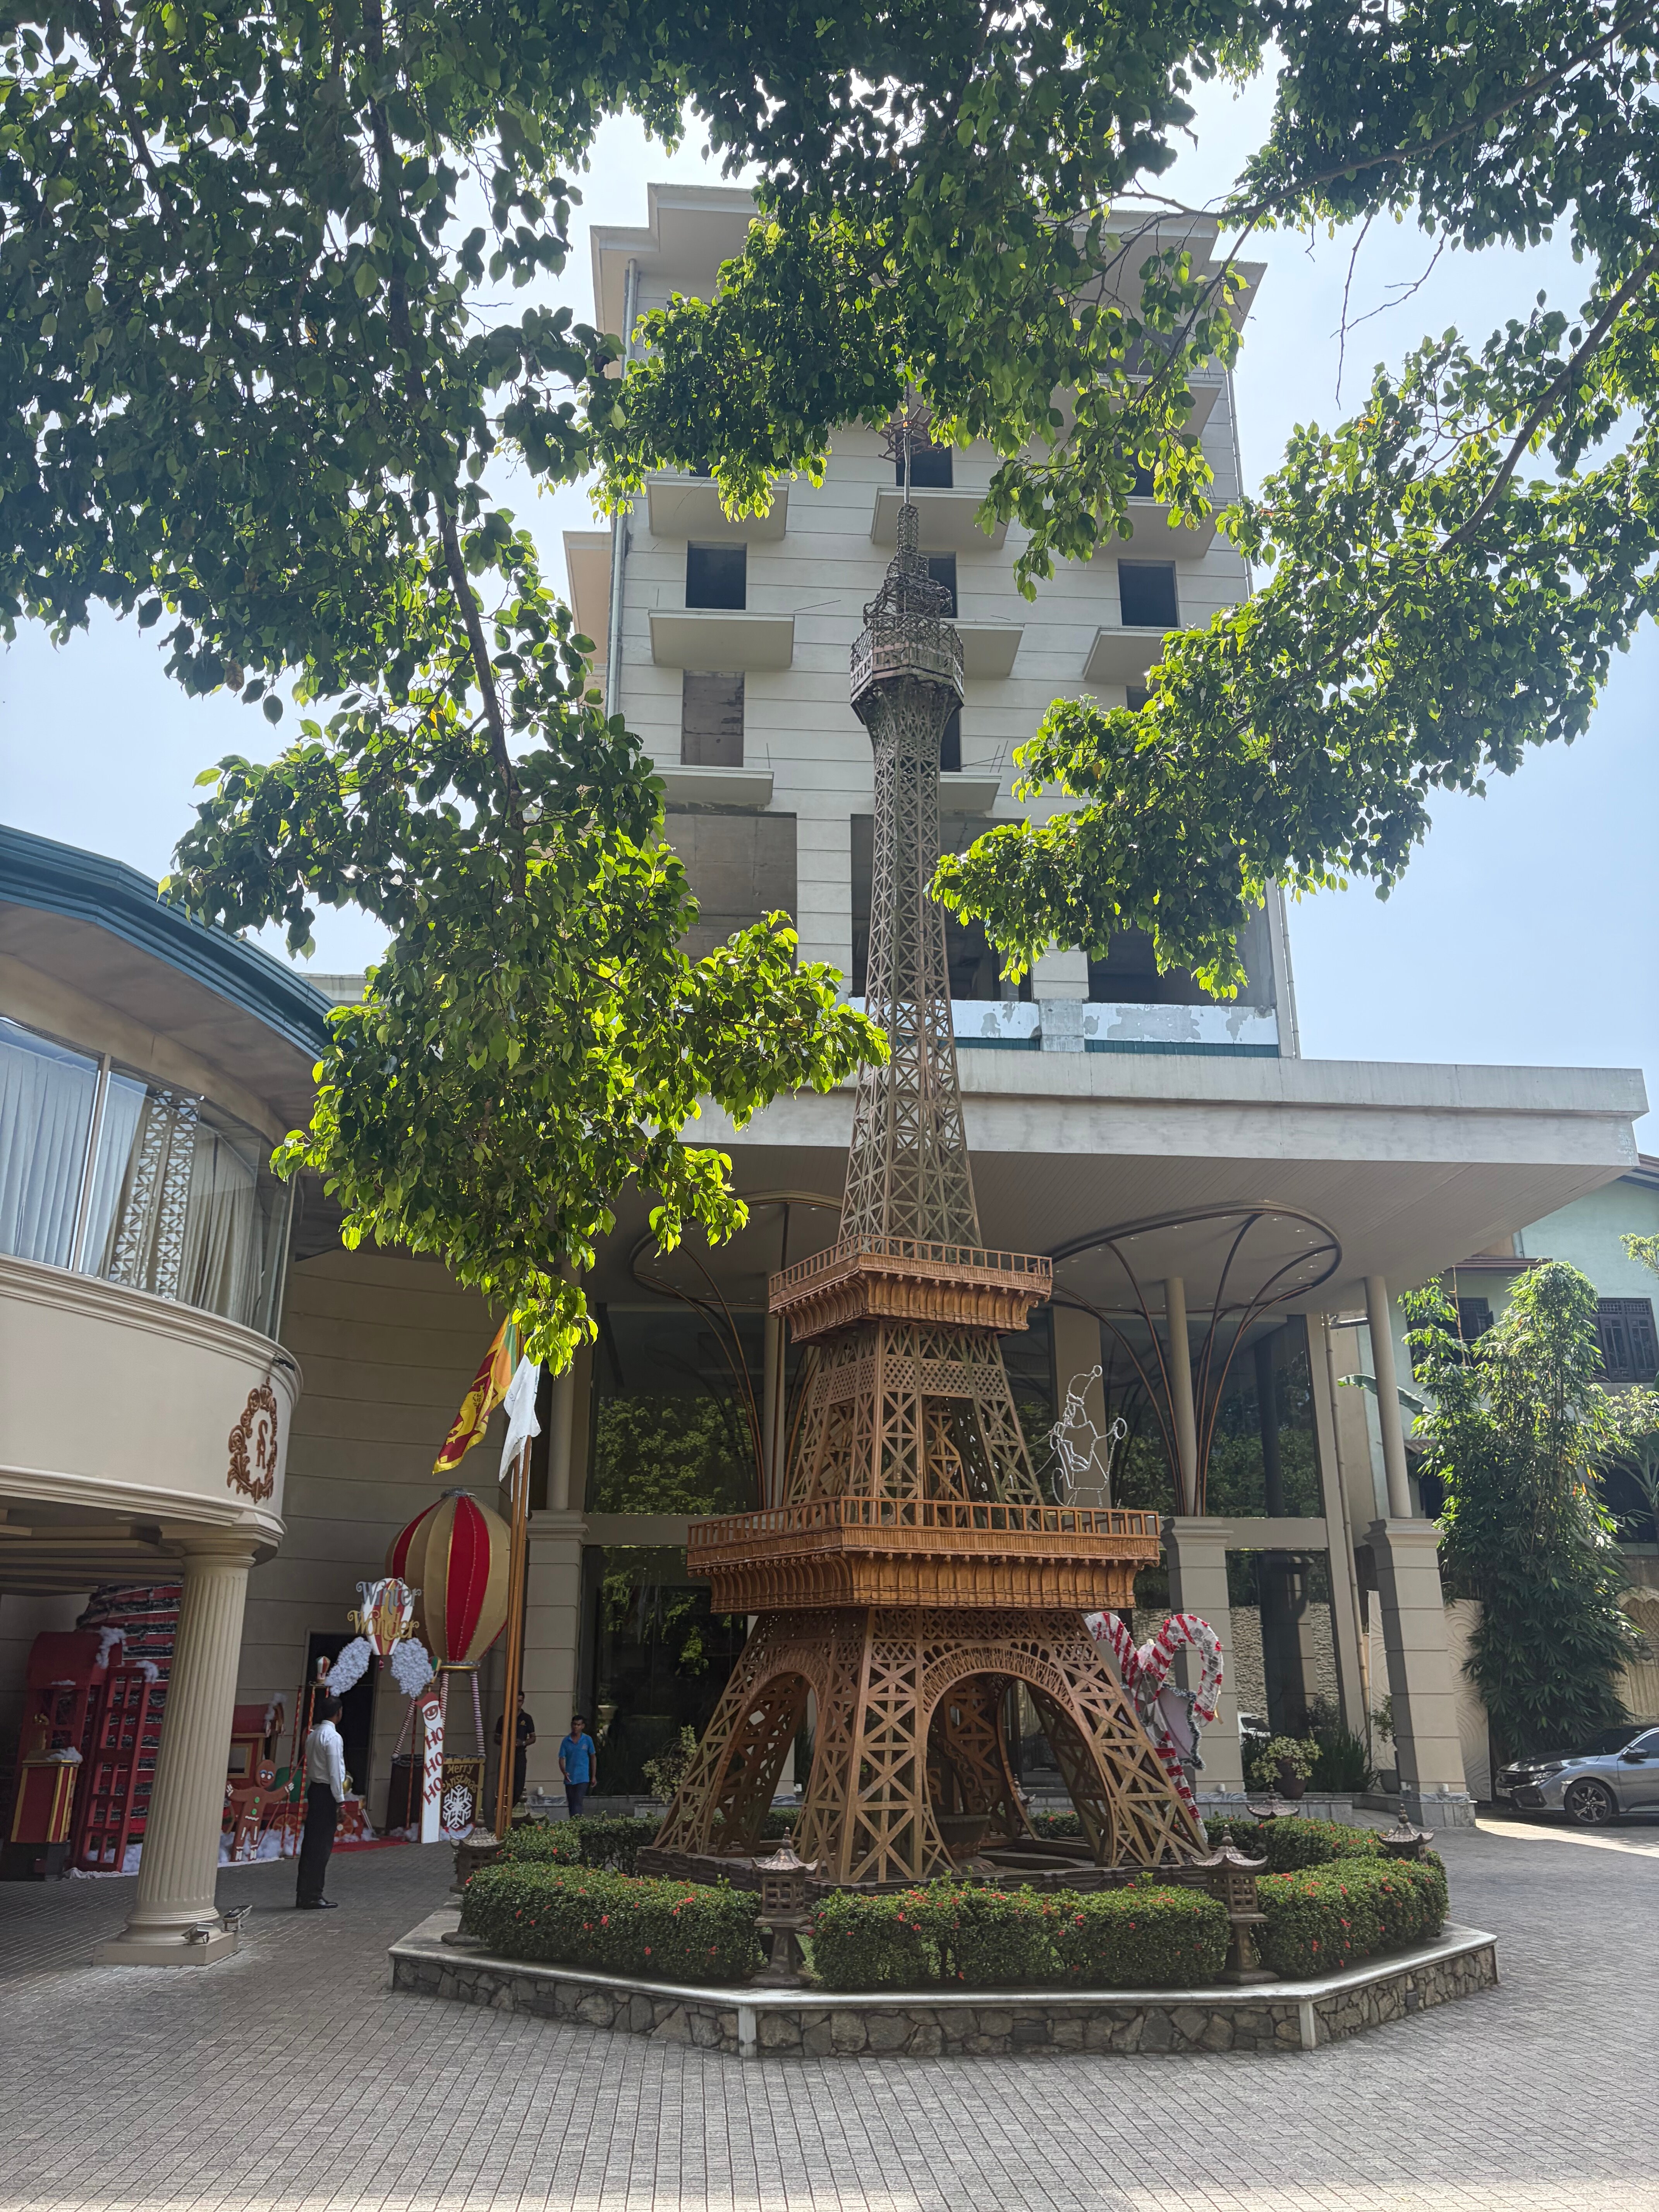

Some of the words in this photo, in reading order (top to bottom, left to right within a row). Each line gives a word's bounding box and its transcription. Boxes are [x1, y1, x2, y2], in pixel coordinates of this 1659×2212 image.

[356, 1577, 421, 1615] Winter
[347, 1610, 419, 1640] Wonder
[424, 1727, 445, 1750] HO
[424, 1752, 445, 1778] HO
[423, 1777, 443, 1805] HO
